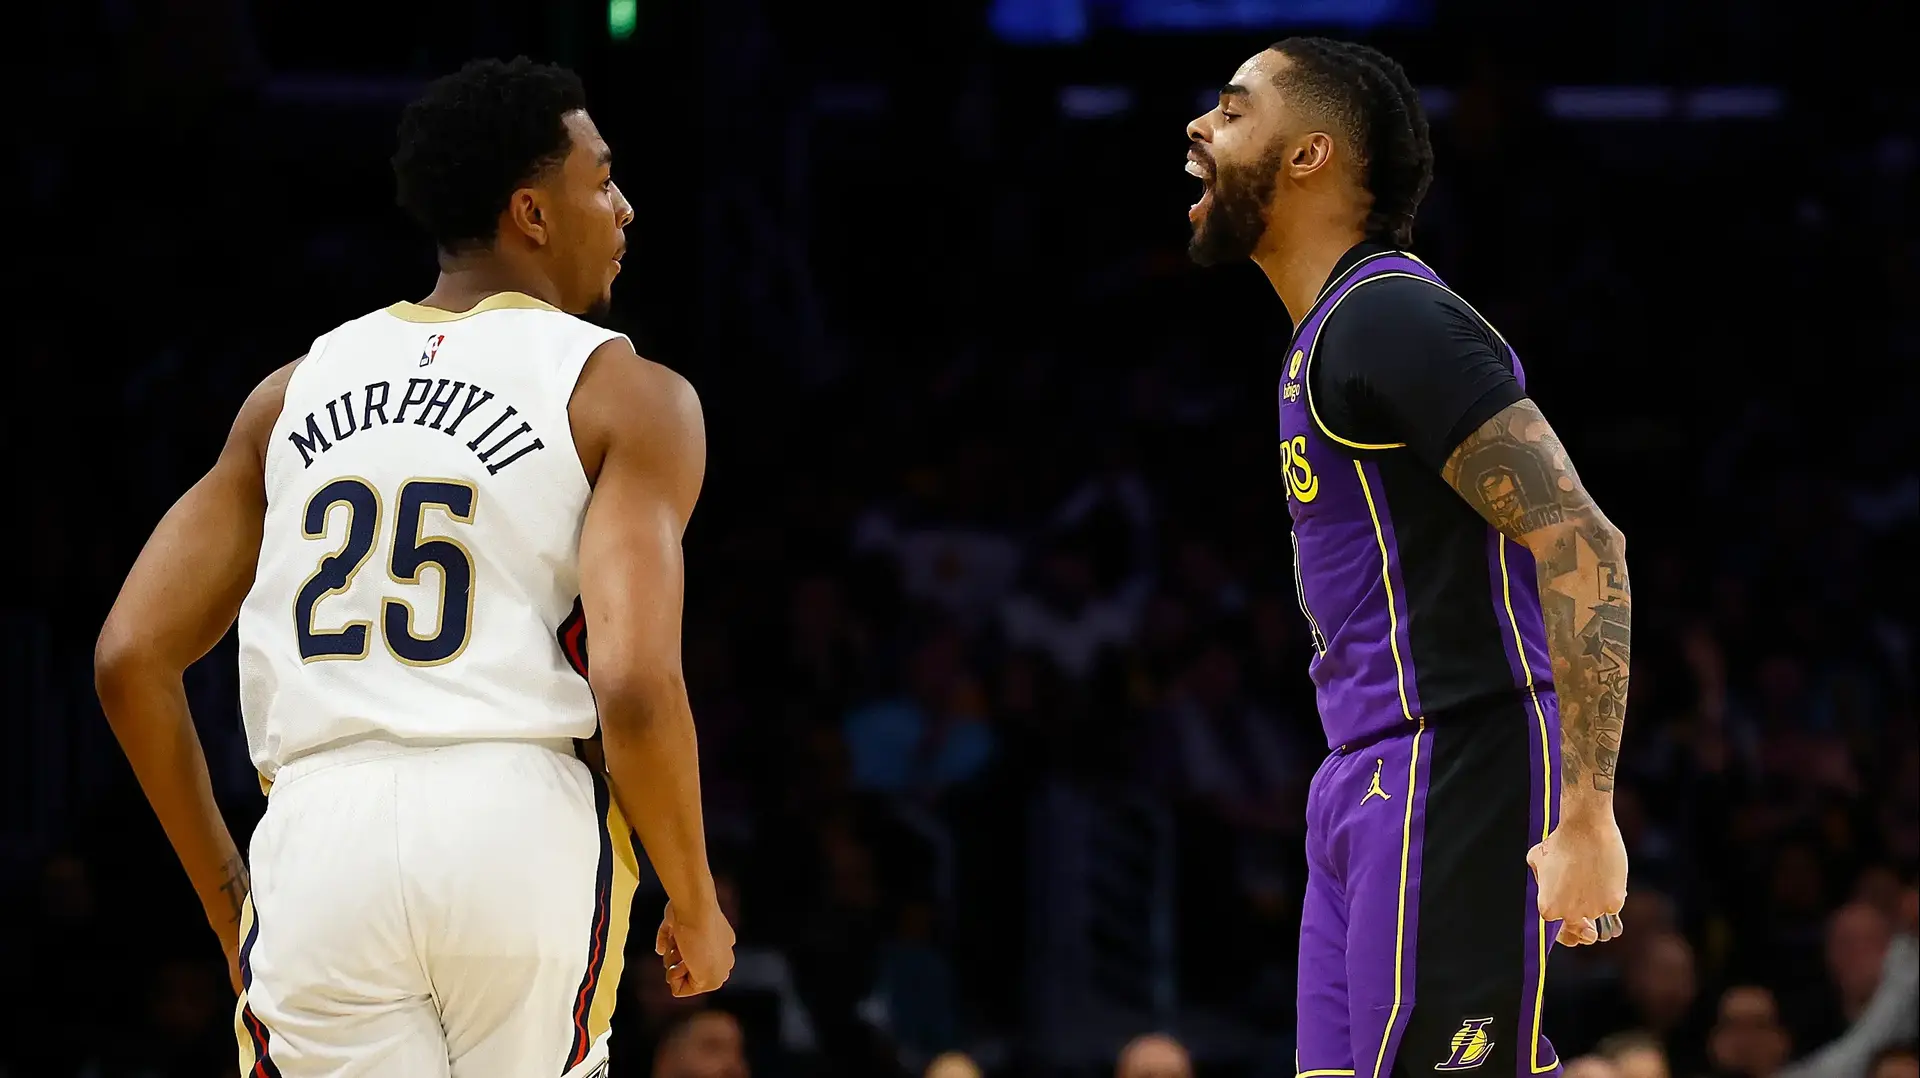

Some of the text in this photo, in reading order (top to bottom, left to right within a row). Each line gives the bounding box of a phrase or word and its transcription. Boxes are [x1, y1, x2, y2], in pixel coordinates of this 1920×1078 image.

[288, 377, 545, 477] MURPHY III
[292, 475, 479, 668] 25
